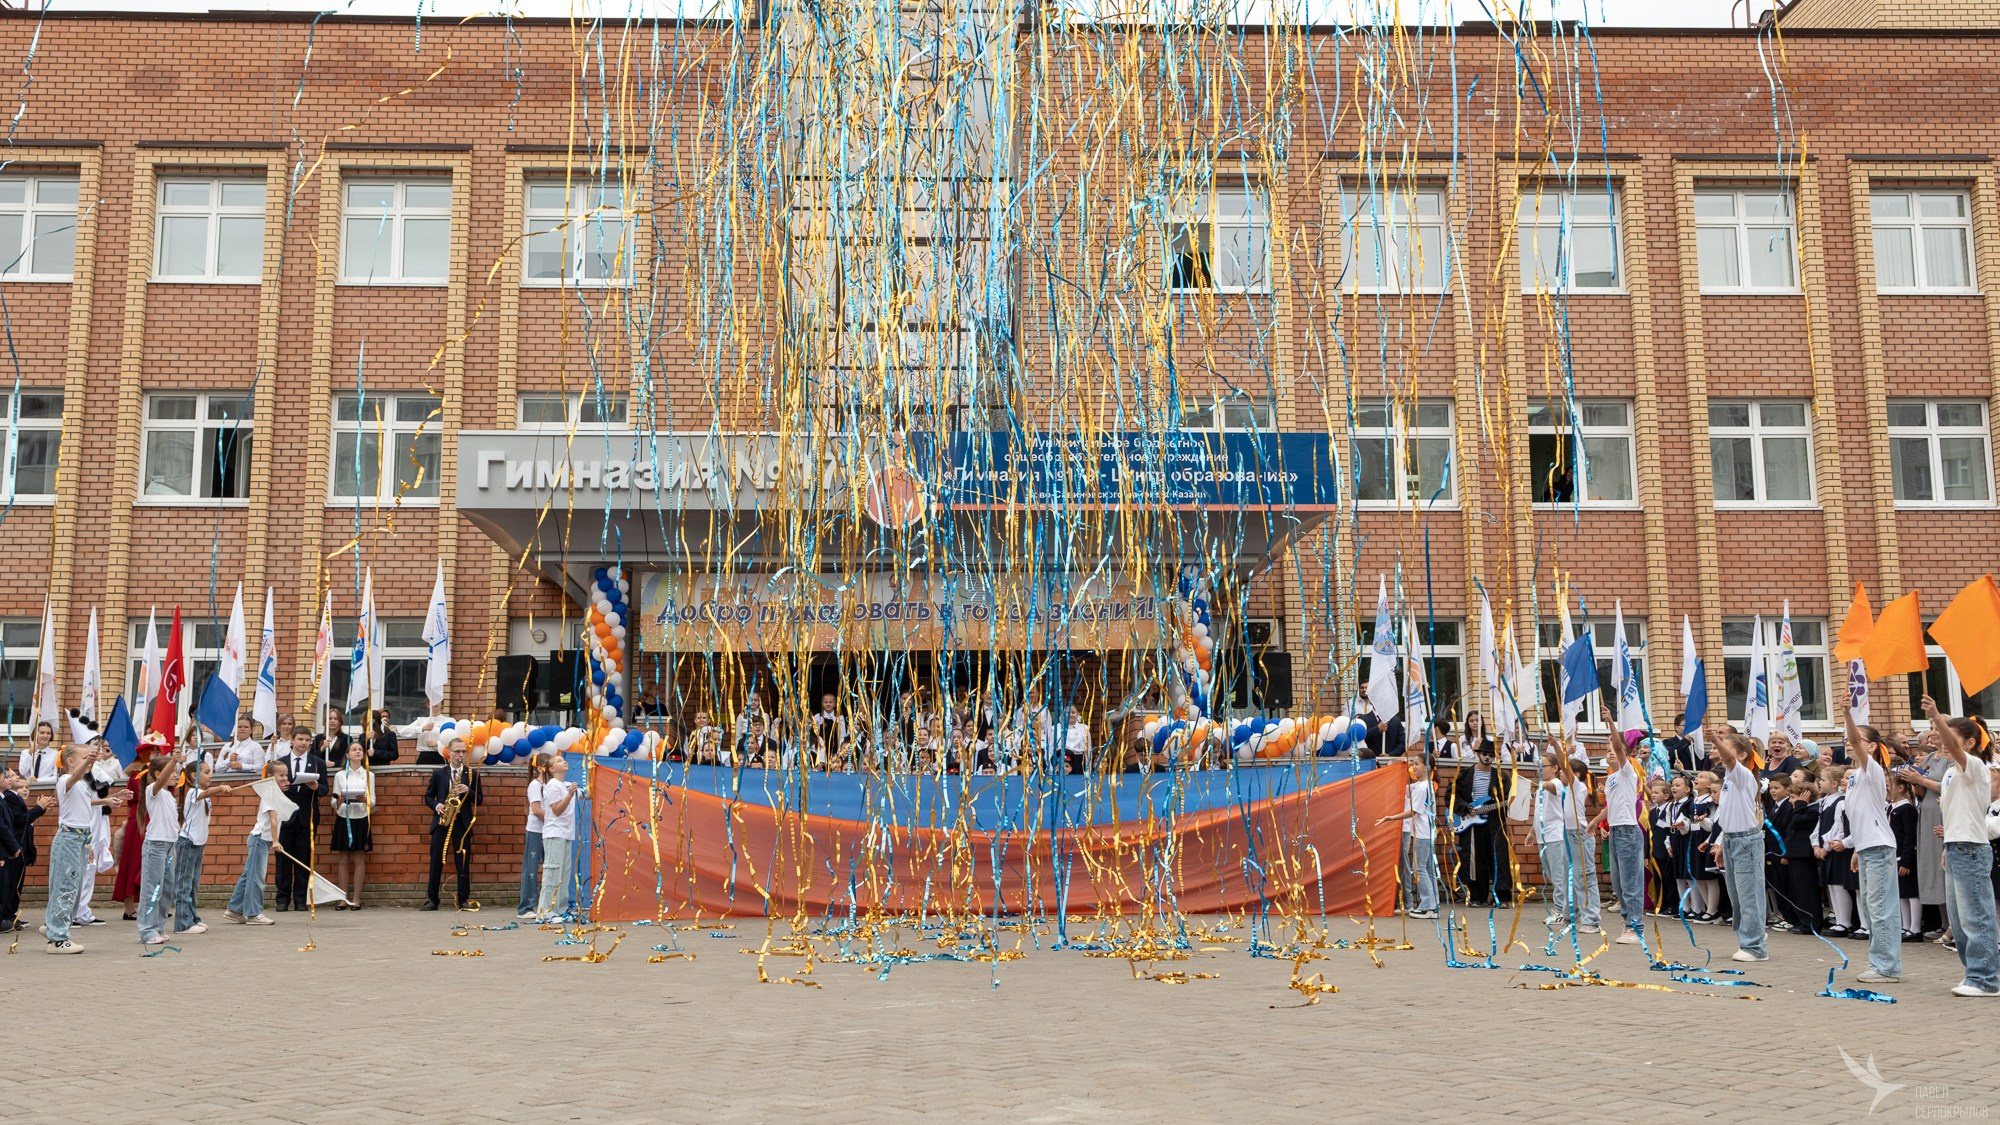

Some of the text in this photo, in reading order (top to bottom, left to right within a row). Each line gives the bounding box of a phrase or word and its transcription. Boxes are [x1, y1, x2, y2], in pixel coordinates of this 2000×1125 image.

[1028, 438, 1129, 449] Муниипальное
[1153, 453, 1229, 463] учреждние
[477, 450, 865, 491] Гимназия №17
[943, 467, 1040, 481] «Гимнаия
[1112, 468, 1163, 485] Цнтр
[656, 600, 753, 625] Добро
[760, 601, 931, 623] пожаовать
[1050, 596, 1155, 621] знаний!
[1786, 724, 1799, 740] КЛУБ
